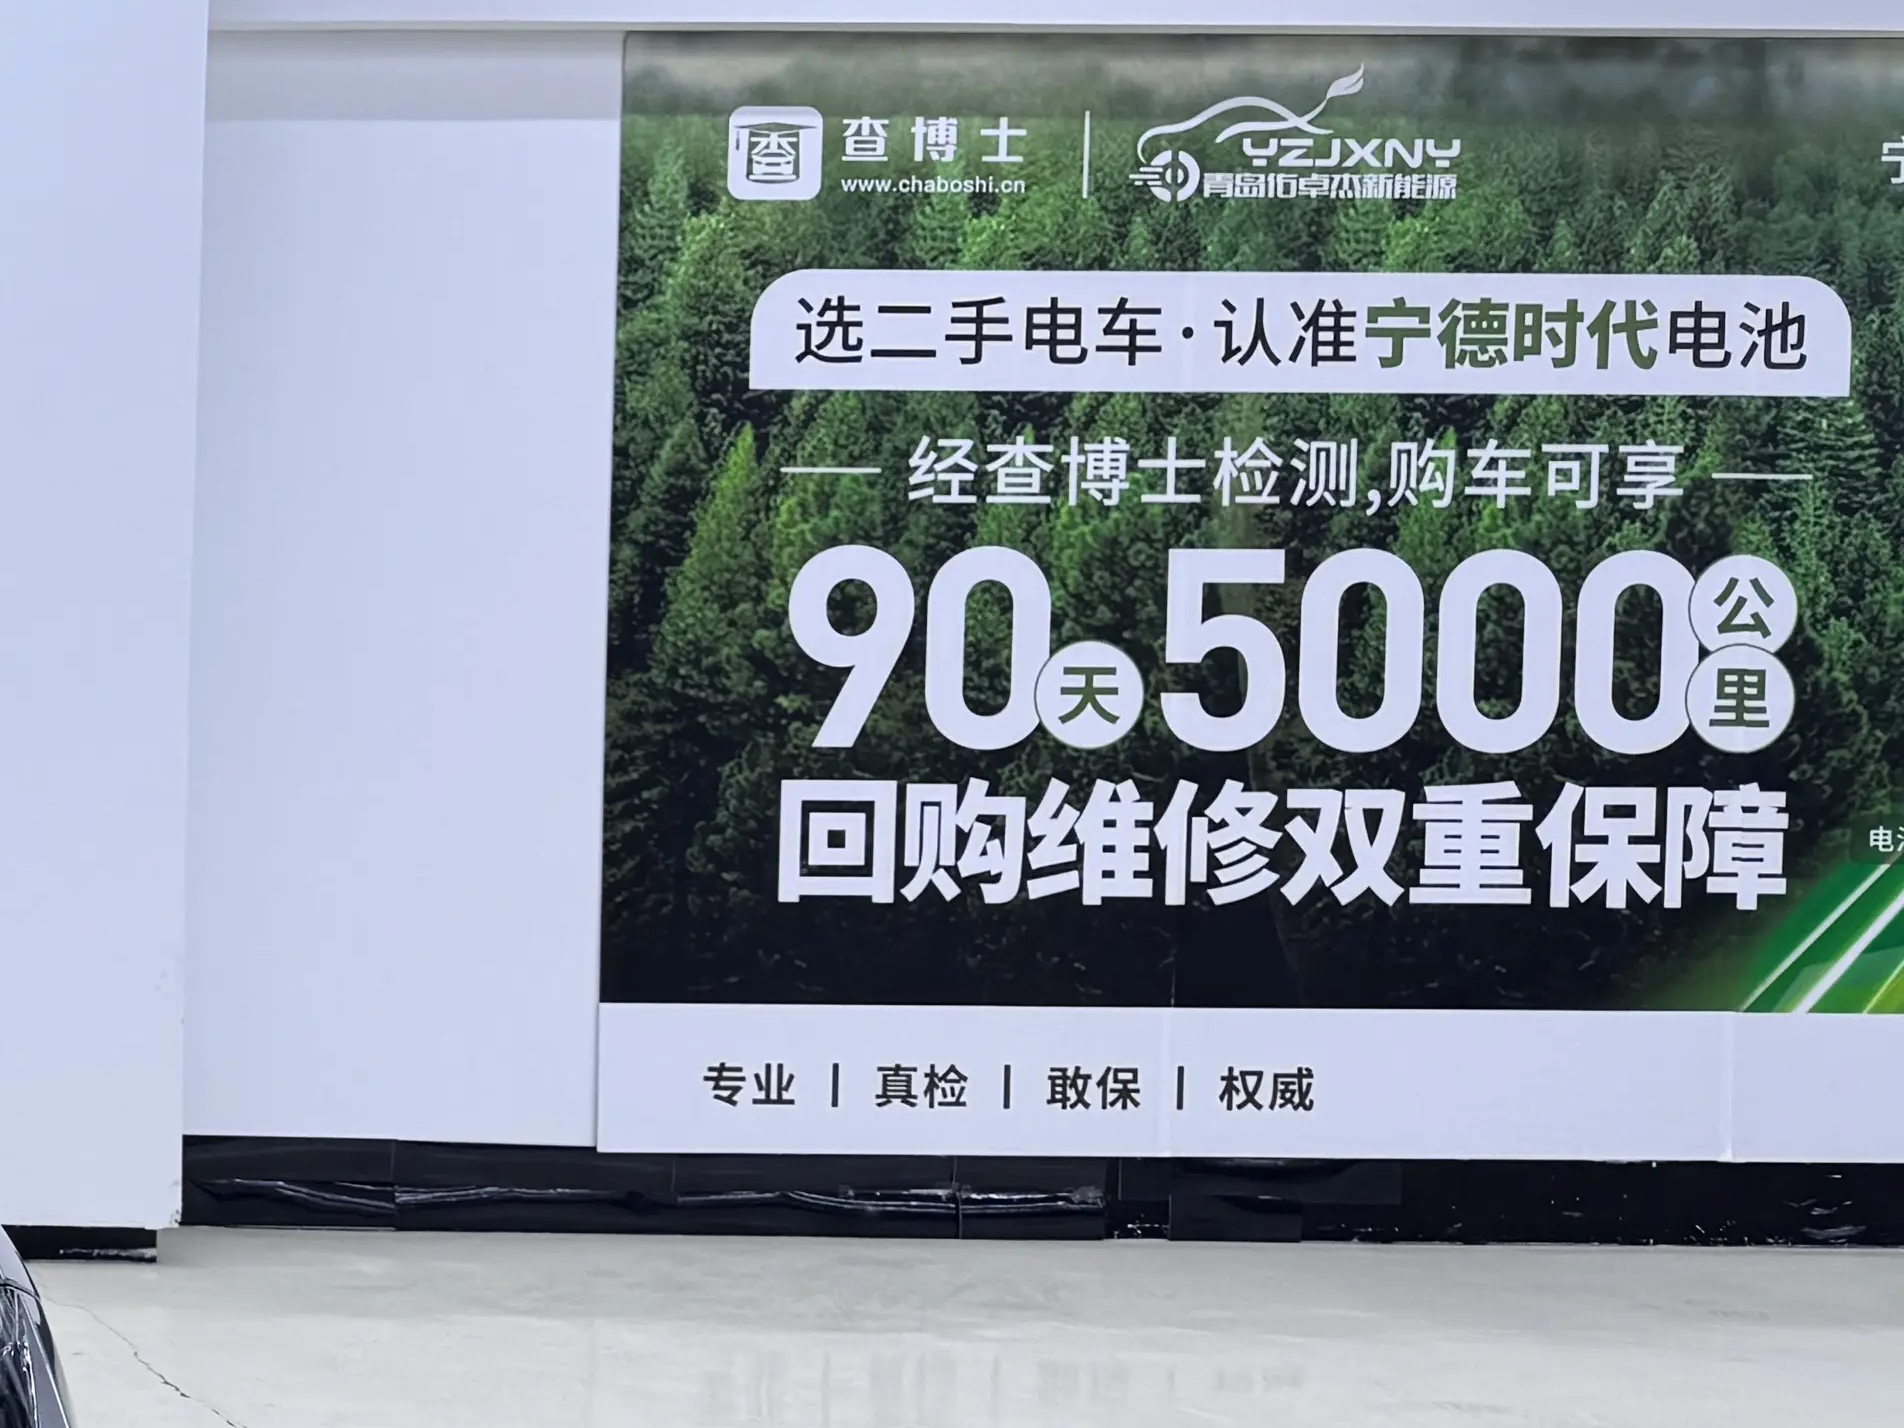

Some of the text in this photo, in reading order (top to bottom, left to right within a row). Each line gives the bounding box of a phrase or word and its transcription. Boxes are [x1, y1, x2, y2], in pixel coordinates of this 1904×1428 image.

[841, 116, 1028, 162] 查博士
[1242, 138, 1461, 168] YZJXNY
[841, 176, 1026, 194] www.chaboshi.cn
[794, 296, 1808, 372] 选二手电车·认准宁德时代电池
[908, 436, 1684, 514] 经查博士检测,购车可享
[778, 779, 1790, 910] 回购维修双重保障
[1869, 825, 1904, 852] 电
[702, 1062, 1316, 1115] 专业 真检 敢保 权威
